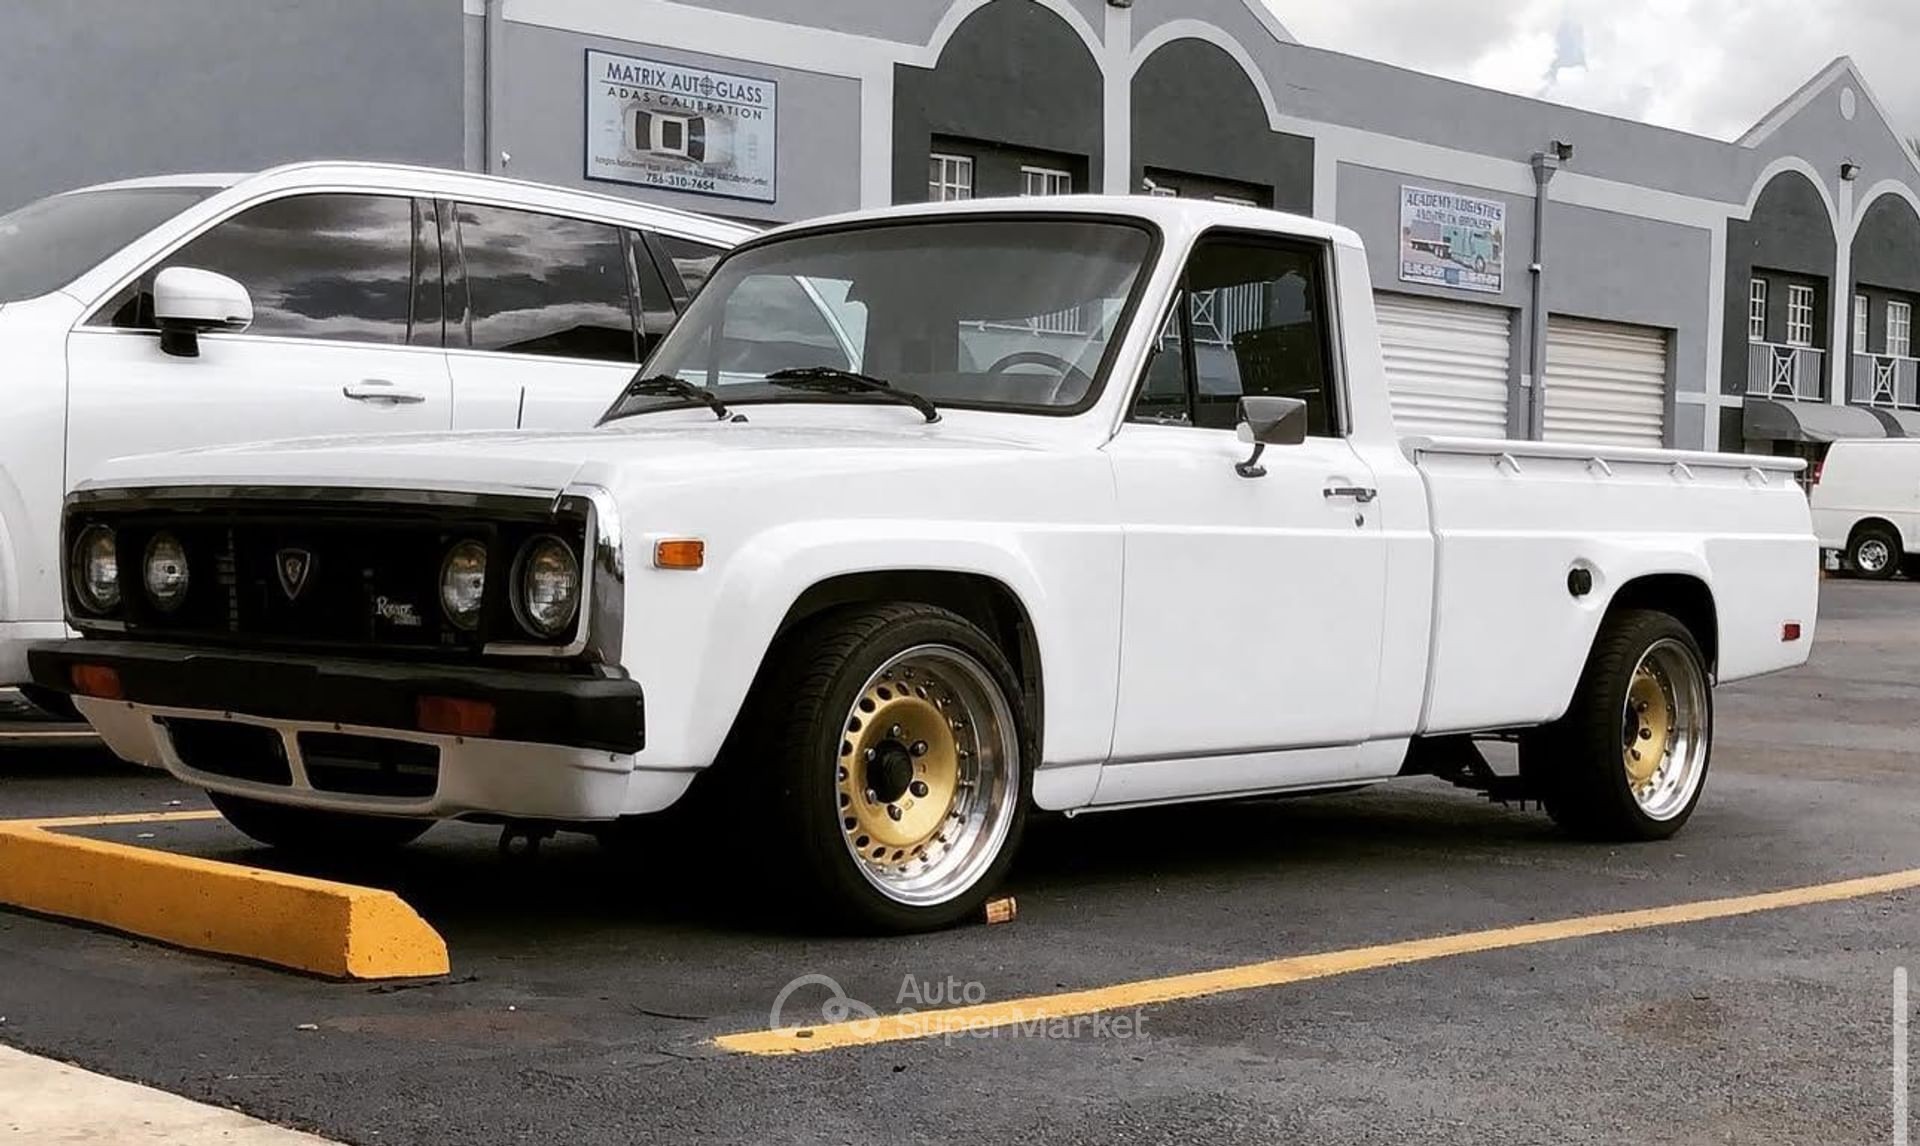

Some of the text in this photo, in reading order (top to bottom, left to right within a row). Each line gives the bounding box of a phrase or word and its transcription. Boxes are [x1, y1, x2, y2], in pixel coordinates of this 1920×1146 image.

[607, 62, 666, 87] MATRIX
[607, 87, 762, 120] ADAS CALIBRATION
[1407, 193, 1501, 220] ACADEMY LOGISTICS
